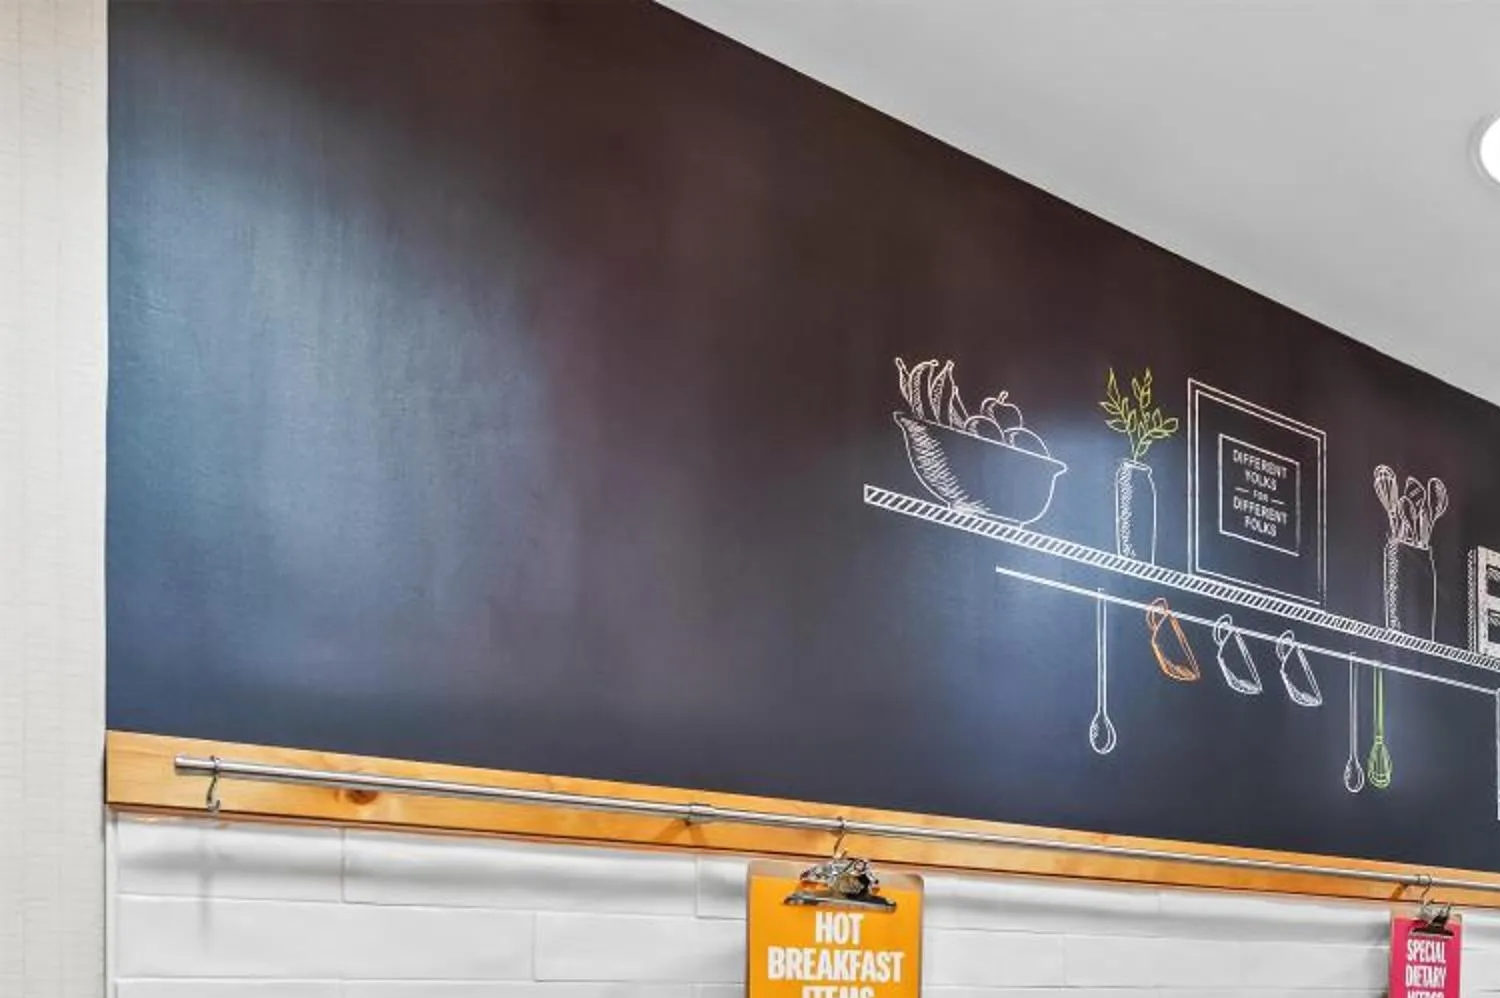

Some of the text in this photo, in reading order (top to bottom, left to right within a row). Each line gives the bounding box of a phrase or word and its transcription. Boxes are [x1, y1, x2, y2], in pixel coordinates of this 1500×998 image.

[1232, 449, 1288, 479] DIFFERENT
[1244, 469, 1277, 492] YOLKS
[1252, 489, 1269, 503] FOR
[1232, 495, 1288, 526] DIFFERENT
[1244, 515, 1277, 537] FOLKS
[814, 910, 865, 946] HOT
[1406, 938, 1447, 964] SPECIAL
[767, 946, 905, 984] BREAKFAST
[1405, 964, 1447, 989] DIETARY
